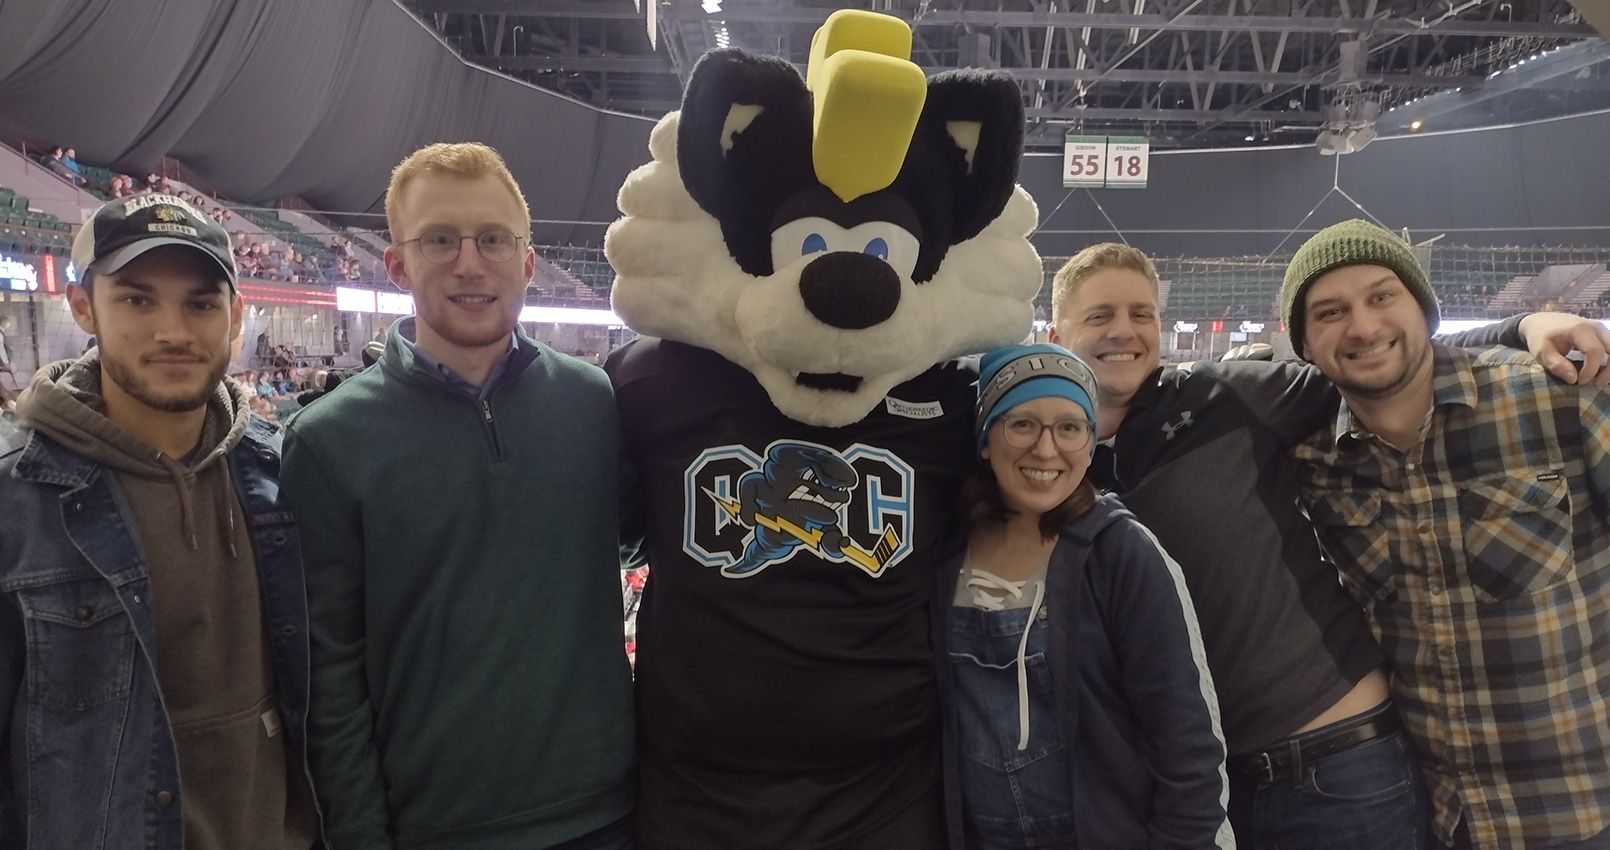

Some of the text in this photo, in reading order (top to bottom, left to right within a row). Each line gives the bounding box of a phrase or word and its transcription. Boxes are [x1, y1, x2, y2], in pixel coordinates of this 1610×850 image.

[1070, 154, 1099, 176] 55
[1114, 155, 1141, 177] 18
[124, 193, 208, 225] BLACKHA
[154, 224, 192, 234] CHICAGO
